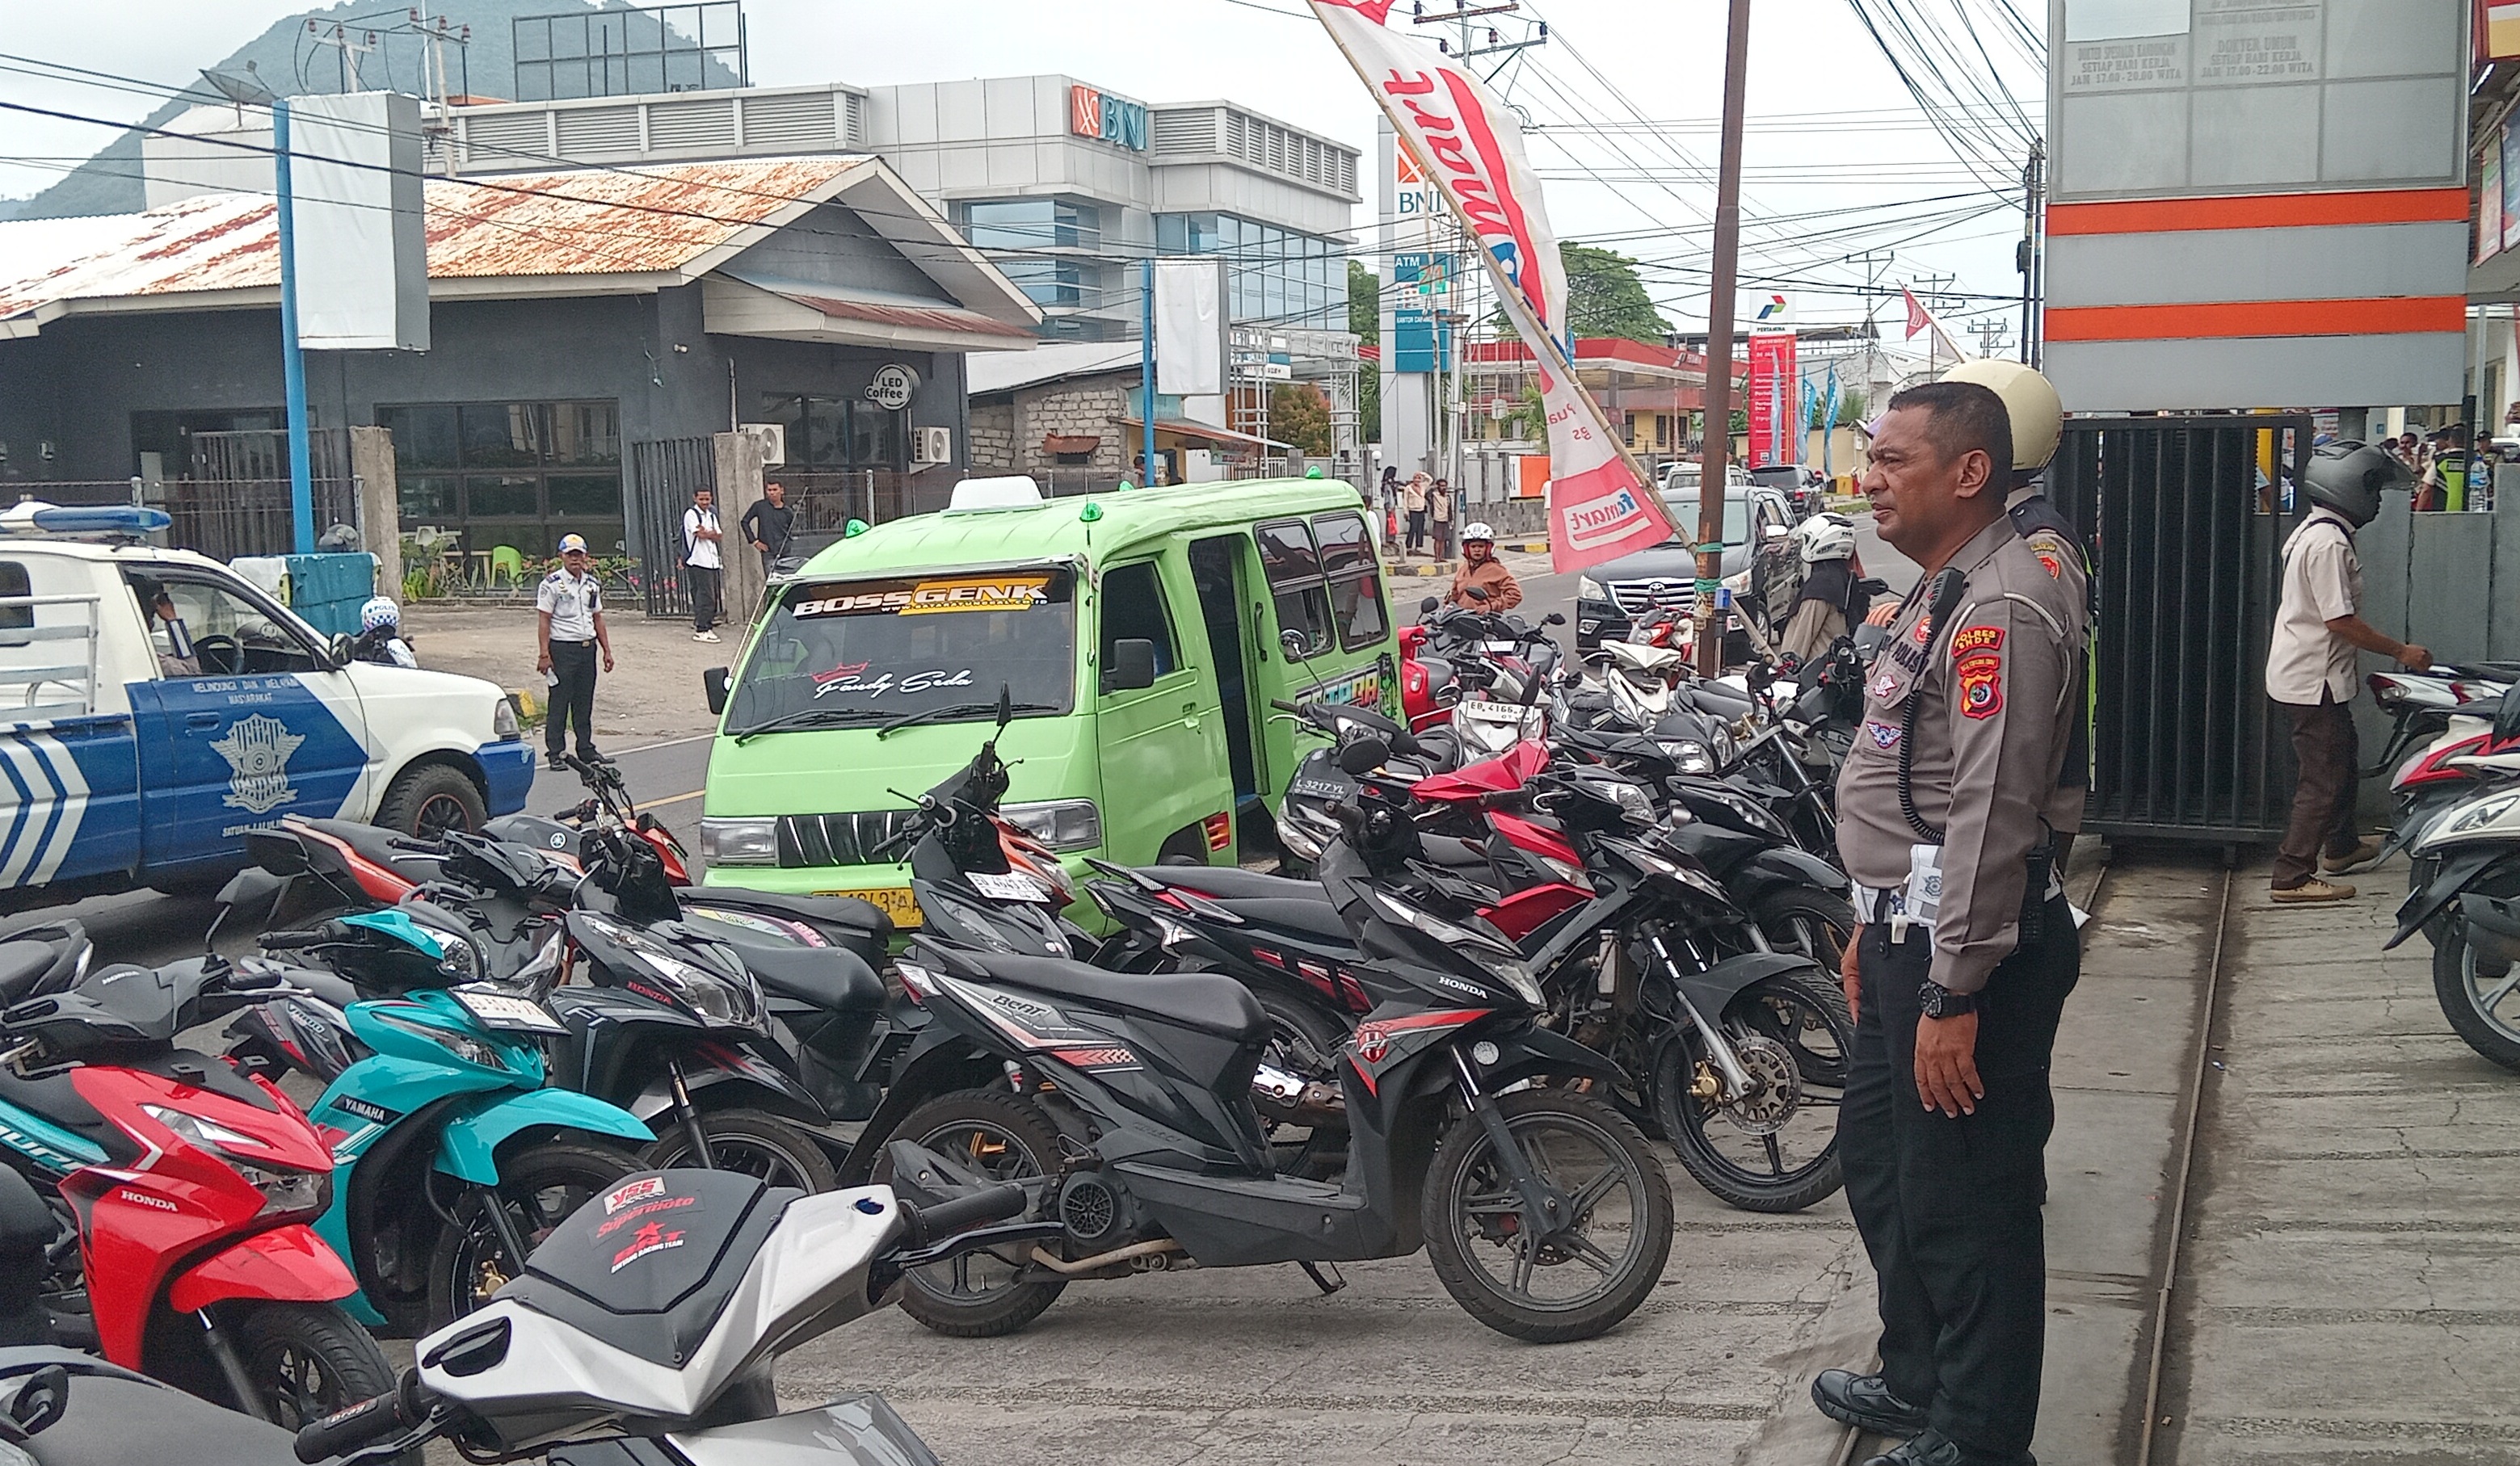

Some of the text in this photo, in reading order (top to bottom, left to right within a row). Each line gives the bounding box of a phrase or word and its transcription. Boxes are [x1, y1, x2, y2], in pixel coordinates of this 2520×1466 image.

[2218, 36, 2297, 53] DOKTER UMUM
[2082, 57, 2170, 73] SETIAP HARI KERJA
[2211, 50, 2303, 65] SETIAP HARI KERJA
[2071, 74, 2091, 86] JAM
[2157, 68, 2181, 80] WITA
[2202, 66, 2220, 78] JAM
[2288, 61, 2314, 74] WITA
[1100, 93, 1146, 152] BNI
[1399, 191, 1441, 214] BNI
[1395, 257, 1420, 267] ATM
[882, 376, 902, 388] LED
[866, 388, 902, 398] Coffee
[242, 679, 259, 691] DAN
[228, 692, 273, 704] MASYARAKAT
[1305, 779, 1332, 792] 3217
[1333, 784, 1344, 795] YL
[101, 970, 141, 985] HONDA
[626, 980, 674, 1006] HONDA
[1438, 976, 1489, 1000] HONDA
[344, 1098, 386, 1122] YAMAHA
[120, 1190, 179, 1212] HONDA
[596, 1196, 696, 1239] Supermoto
[637, 1243, 665, 1258] RACING
[664, 1239, 684, 1250] TEAM
